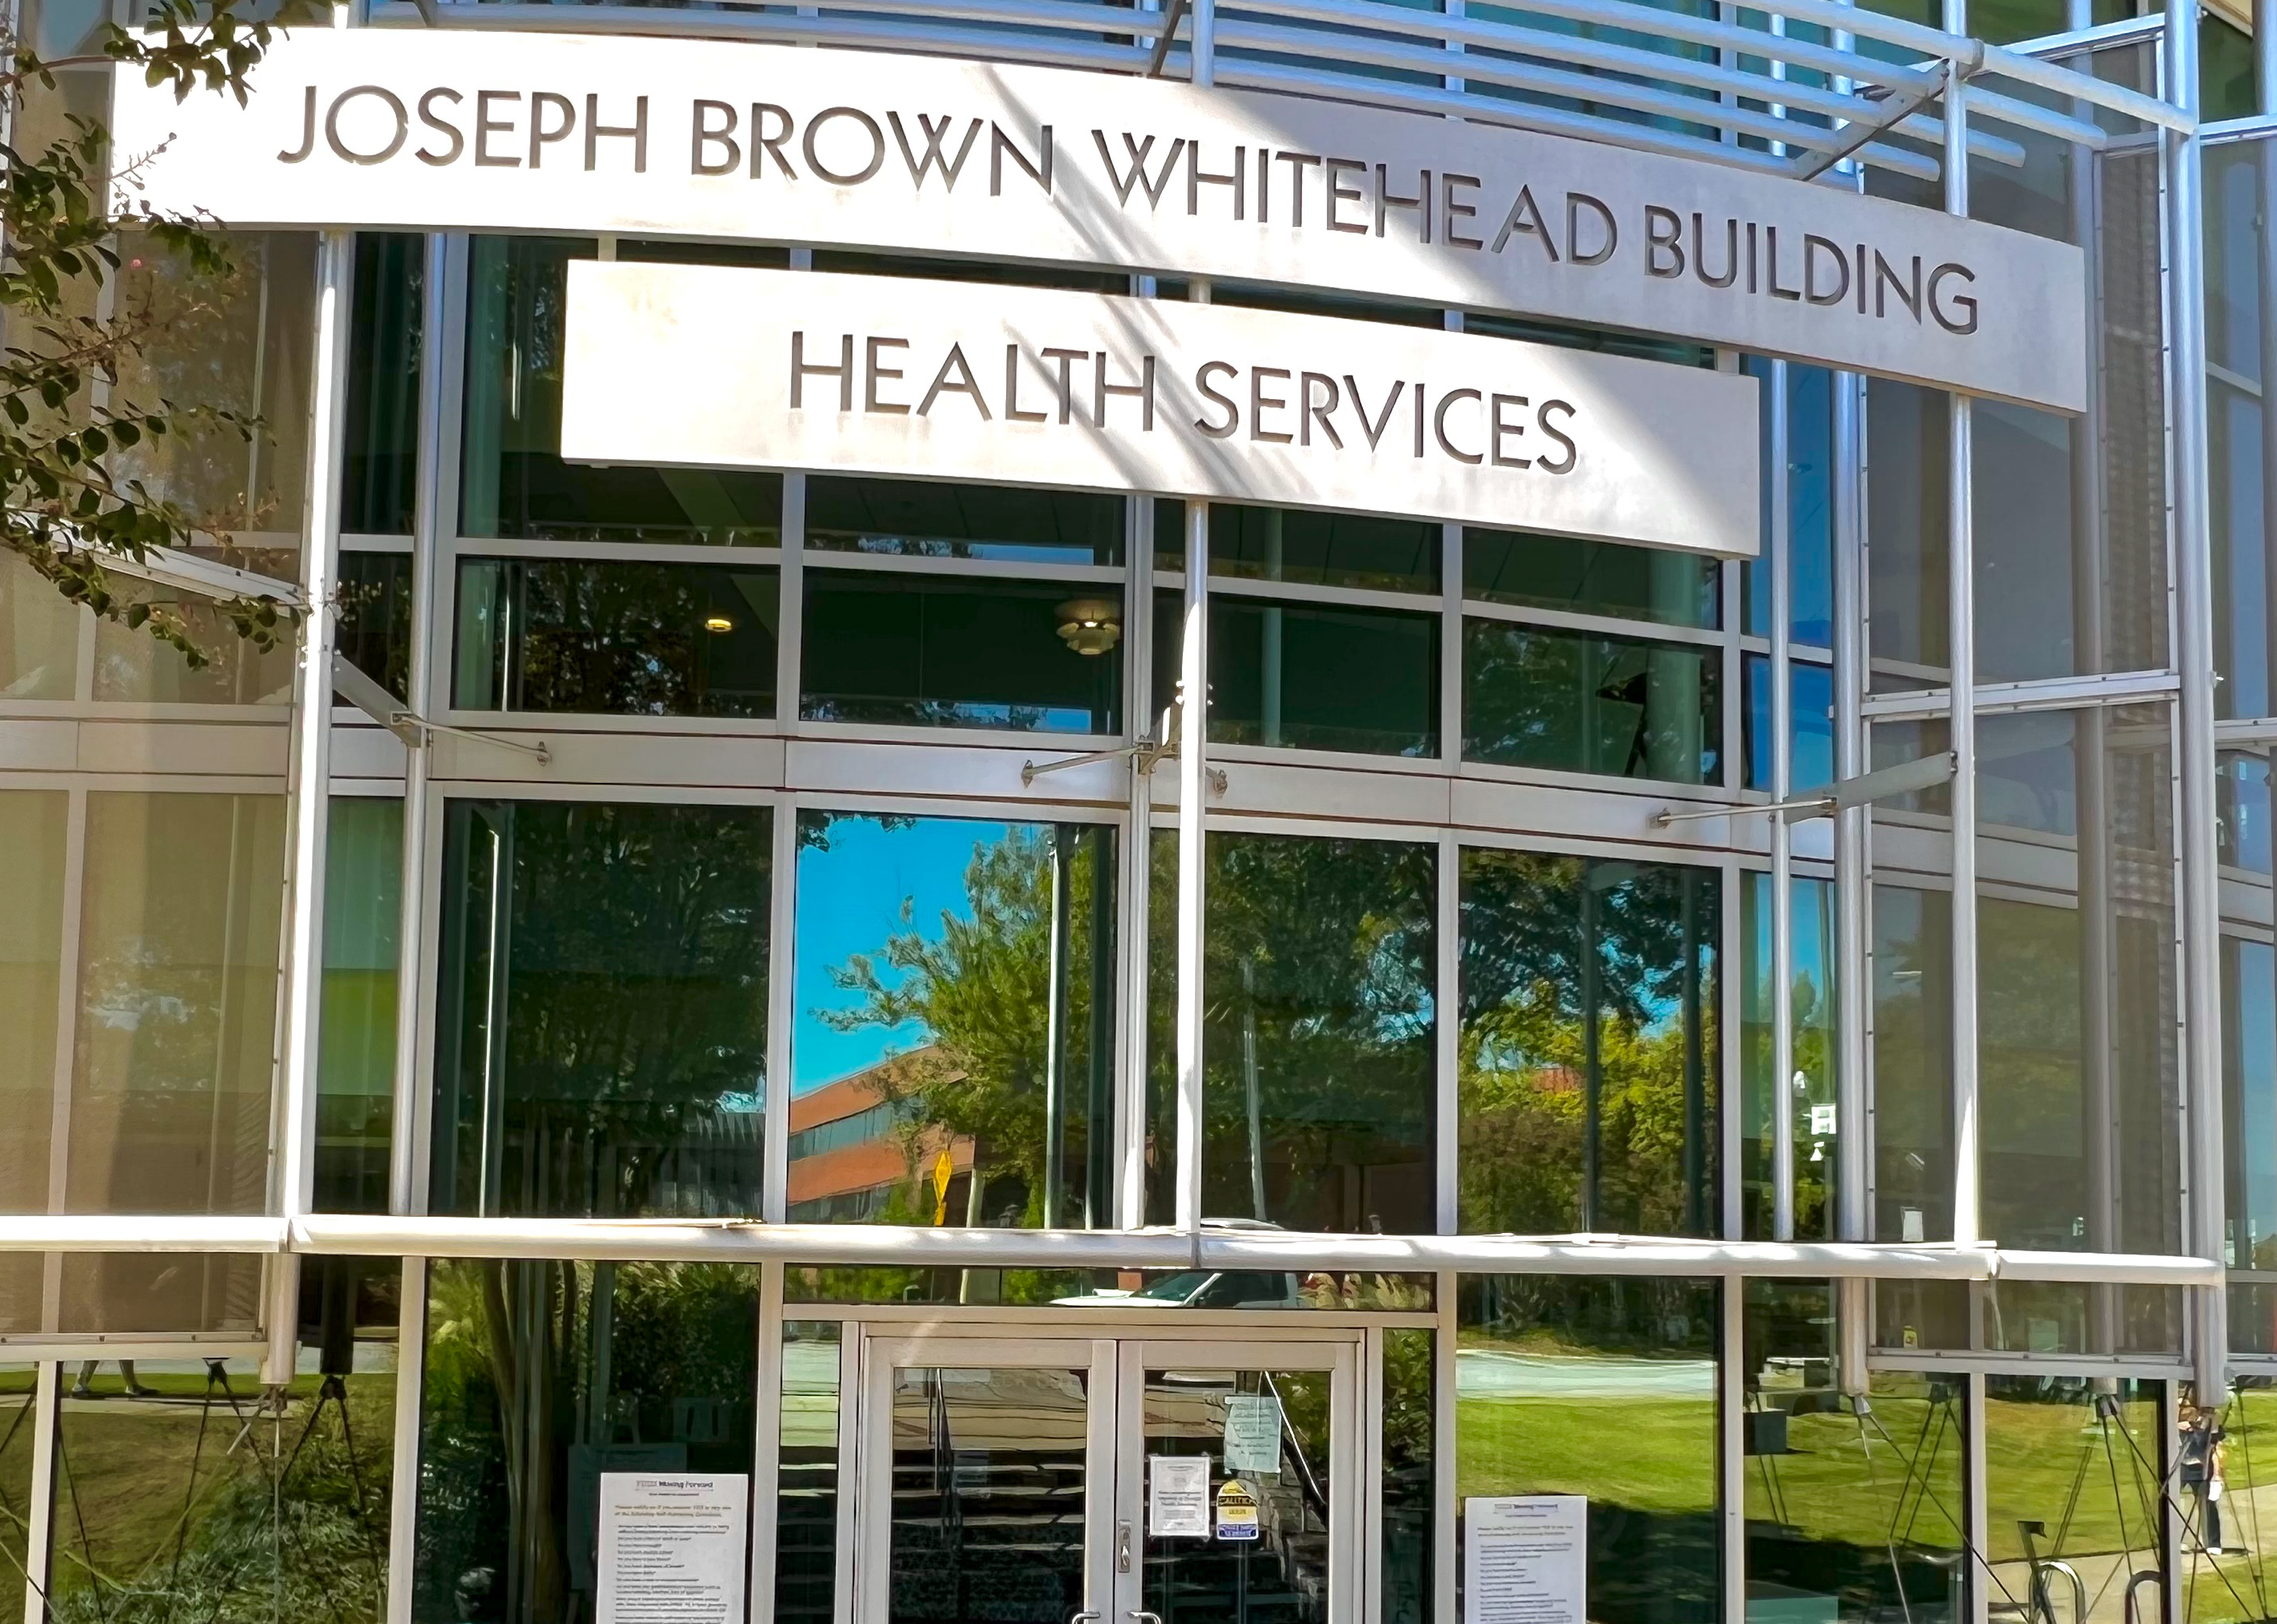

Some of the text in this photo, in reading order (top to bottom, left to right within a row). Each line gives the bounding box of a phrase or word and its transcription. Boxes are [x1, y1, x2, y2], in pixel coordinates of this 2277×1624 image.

[277, 85, 1978, 335] JOSEPH BROWN WHITEHEAD BUILDING
[790, 330, 1577, 474] HEALTH SERVICES
